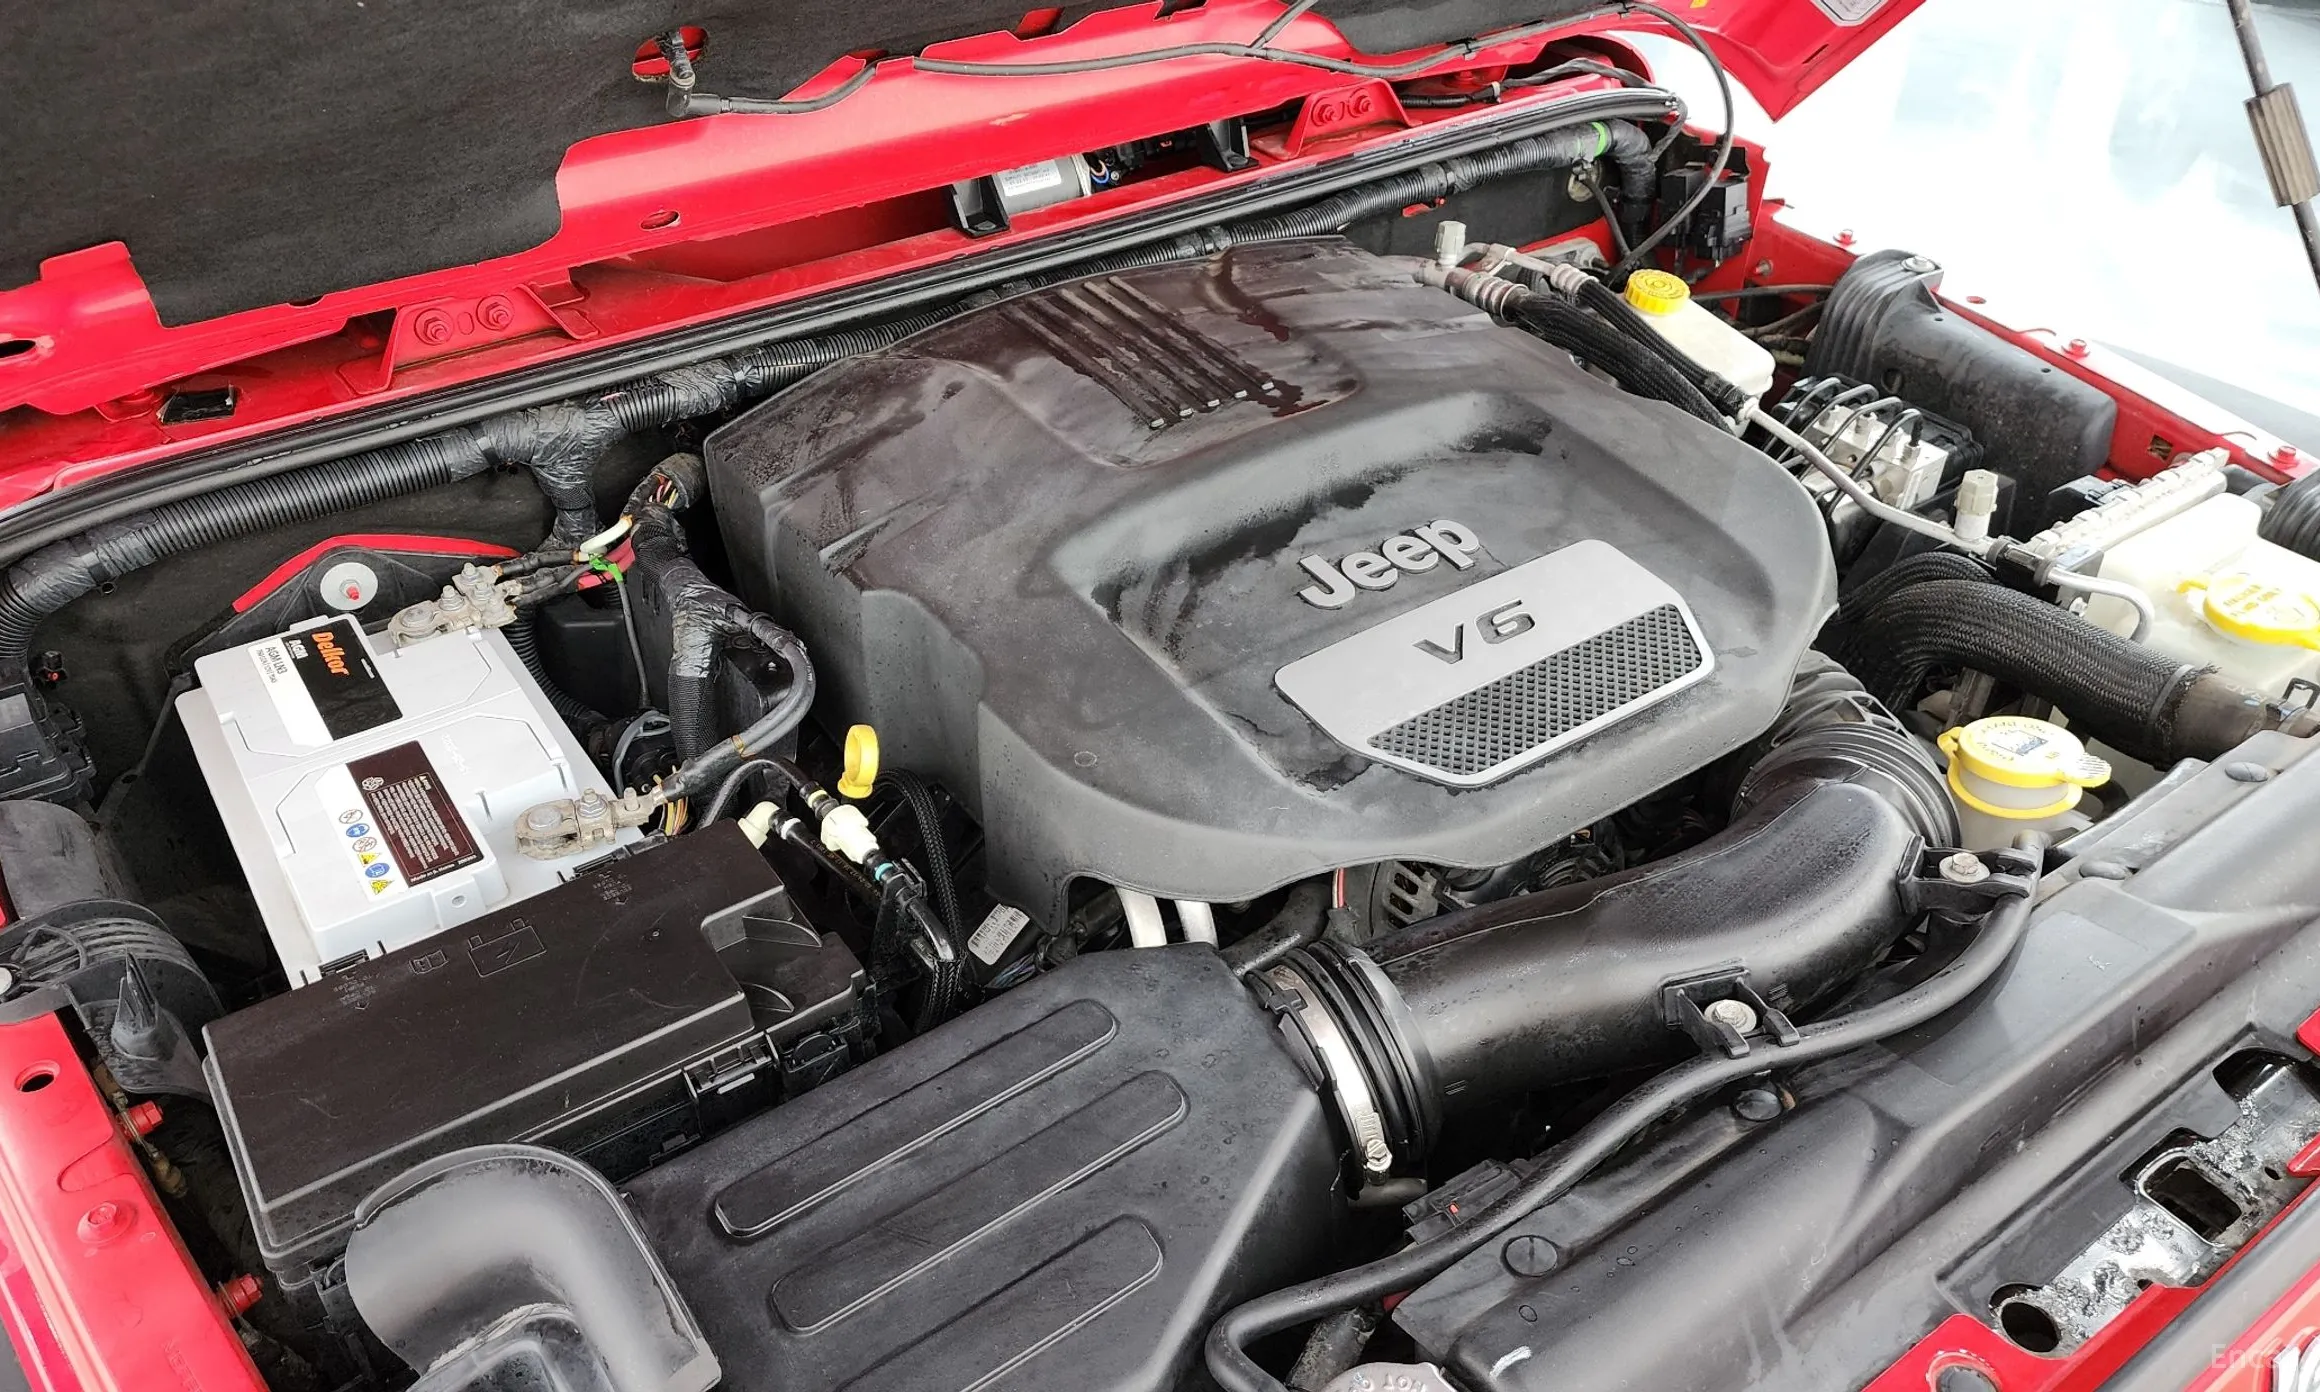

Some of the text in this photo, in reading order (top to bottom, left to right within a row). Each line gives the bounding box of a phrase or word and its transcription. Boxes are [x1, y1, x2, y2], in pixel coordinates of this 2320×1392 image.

[1297, 519, 1480, 611] Jeep
[264, 646, 281, 662] AGM
[288, 639, 309, 660] AGM
[311, 631, 350, 676] Delkor
[1412, 598, 1536, 665] V6
